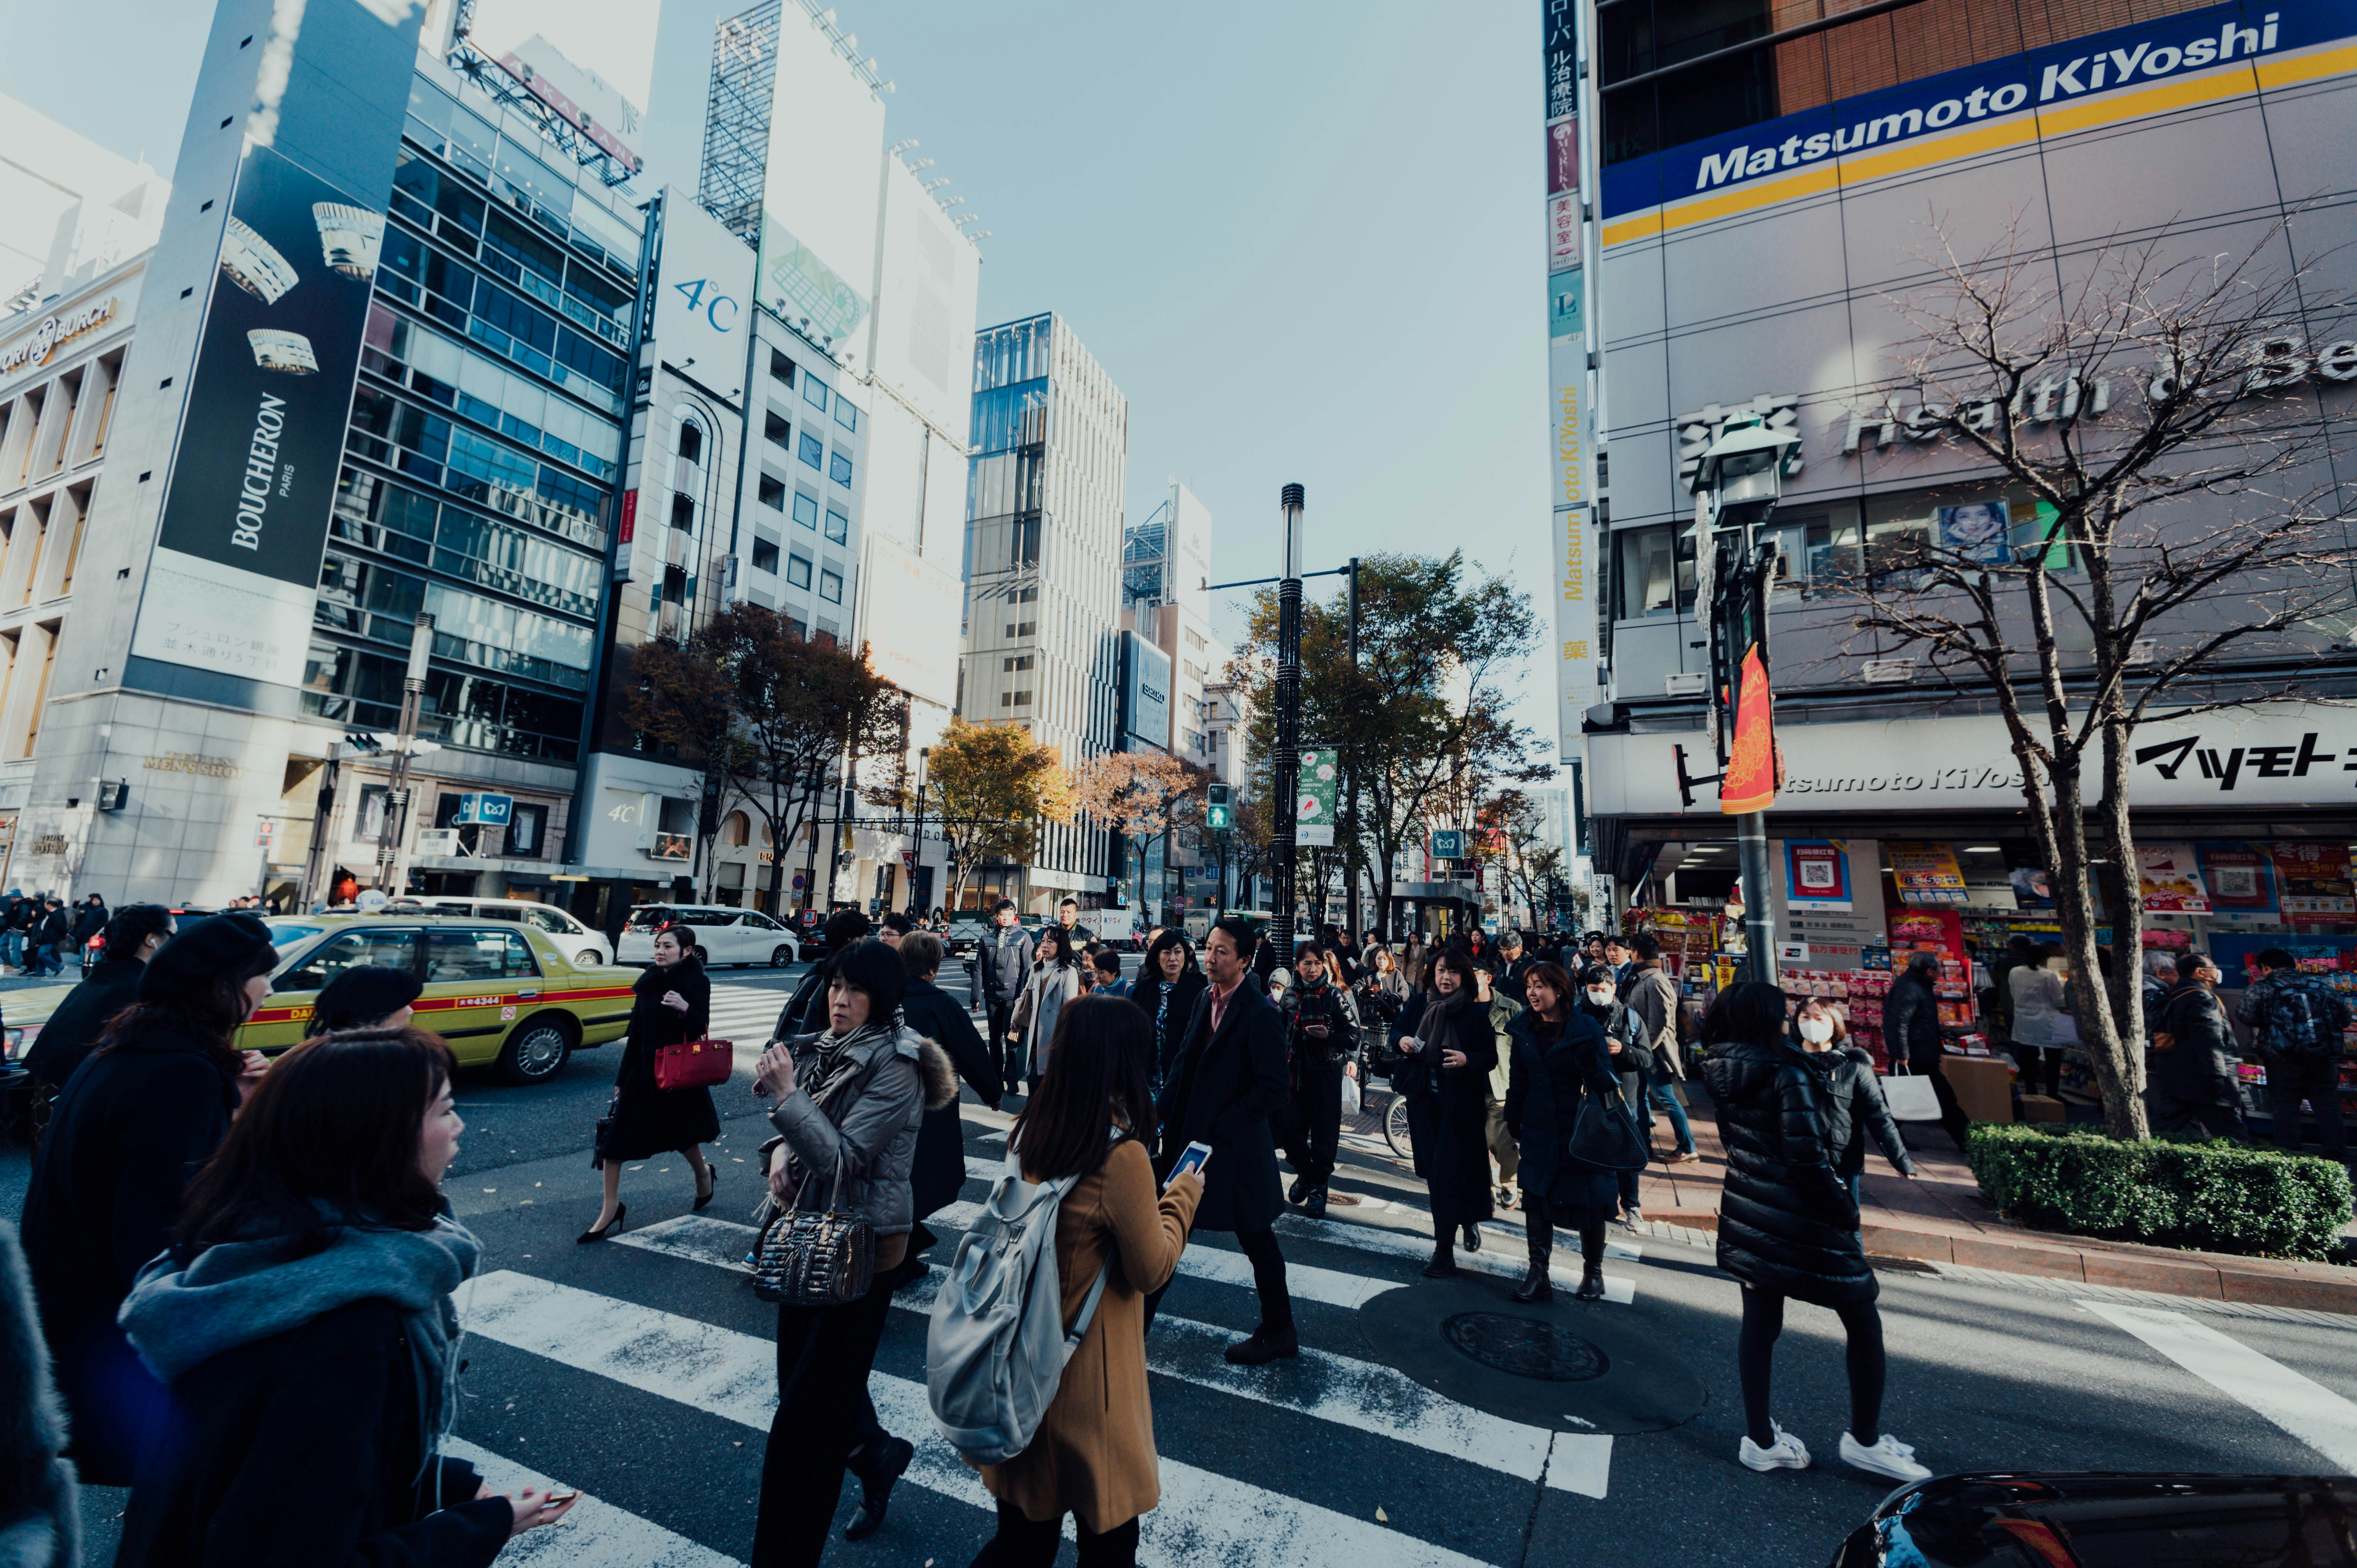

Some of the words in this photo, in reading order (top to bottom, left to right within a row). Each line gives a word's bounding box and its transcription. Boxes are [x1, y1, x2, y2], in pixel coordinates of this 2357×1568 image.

[1695, 83, 2028, 190] Matsumoto
[2039, 12, 2280, 102] KiYoshi
[1556, 199, 1573, 245] 美容室
[55, 296, 118, 343] BURCH
[1551, 312, 1581, 324] CLINIC
[1568, 333, 1581, 342] 4F
[1560, 386, 1579, 462] KiYoshi
[231, 391, 287, 552] BOUCHERON
[279, 463, 295, 498] PARIS
[163, 637, 278, 671] 並木通り5丁目
[1563, 639, 1589, 661] 薬
[1142, 682, 1166, 704] SEIKO
[143, 757, 196, 774] MEN'S
[199, 764, 248, 779] SHOP
[165, 750, 232, 766] TEIJIN
[1785, 773, 1924, 793] tsumoto
[1930, 768, 2051, 789] KiYos
